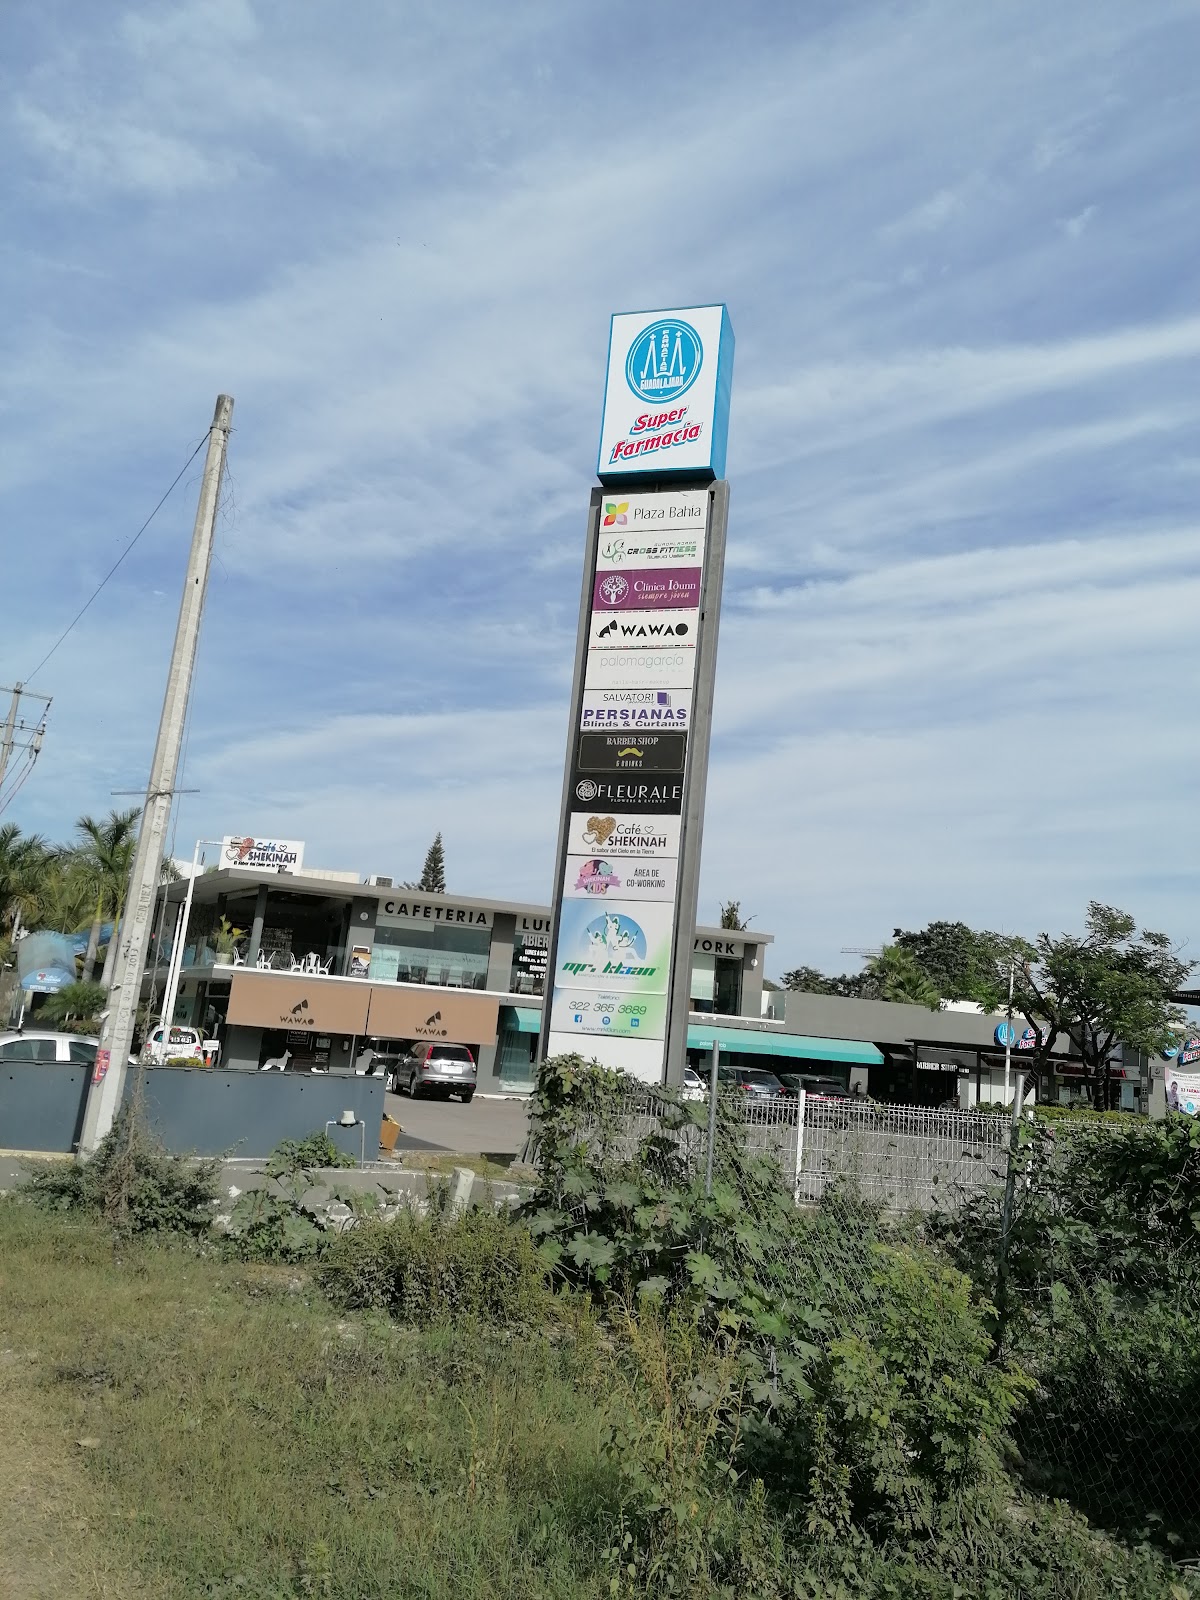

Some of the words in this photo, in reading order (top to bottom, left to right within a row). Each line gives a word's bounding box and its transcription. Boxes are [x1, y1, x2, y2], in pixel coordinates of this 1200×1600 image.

[660, 330, 669, 372] FARMACIAS
[640, 376, 684, 390] GUADALAJARA
[630, 405, 688, 435] Super
[609, 421, 703, 464] Farmacia
[633, 507, 665, 519] Plaza
[669, 505, 701, 518] Bahía
[603, 693, 654, 702] SALVATORI
[583, 708, 687, 720] PERSIANAS
[606, 737, 636, 746] BARBER
[638, 737, 659, 745] SHOP
[598, 784, 681, 799] FLEURALE
[616, 824, 641, 834] Café
[256, 842, 276, 852] Café
[608, 836, 667, 848] SHEKINAH
[248, 852, 297, 864] SHEKINAH
[652, 870, 660, 878] DE
[586, 882, 606, 894] KIDS
[626, 879, 666, 888] CO-WORKING
[385, 902, 487, 924] CAFETERIA
[568, 1001, 590, 1011] 322
[593, 1003, 614, 1012] 365
[618, 1005, 647, 1015] 3689
